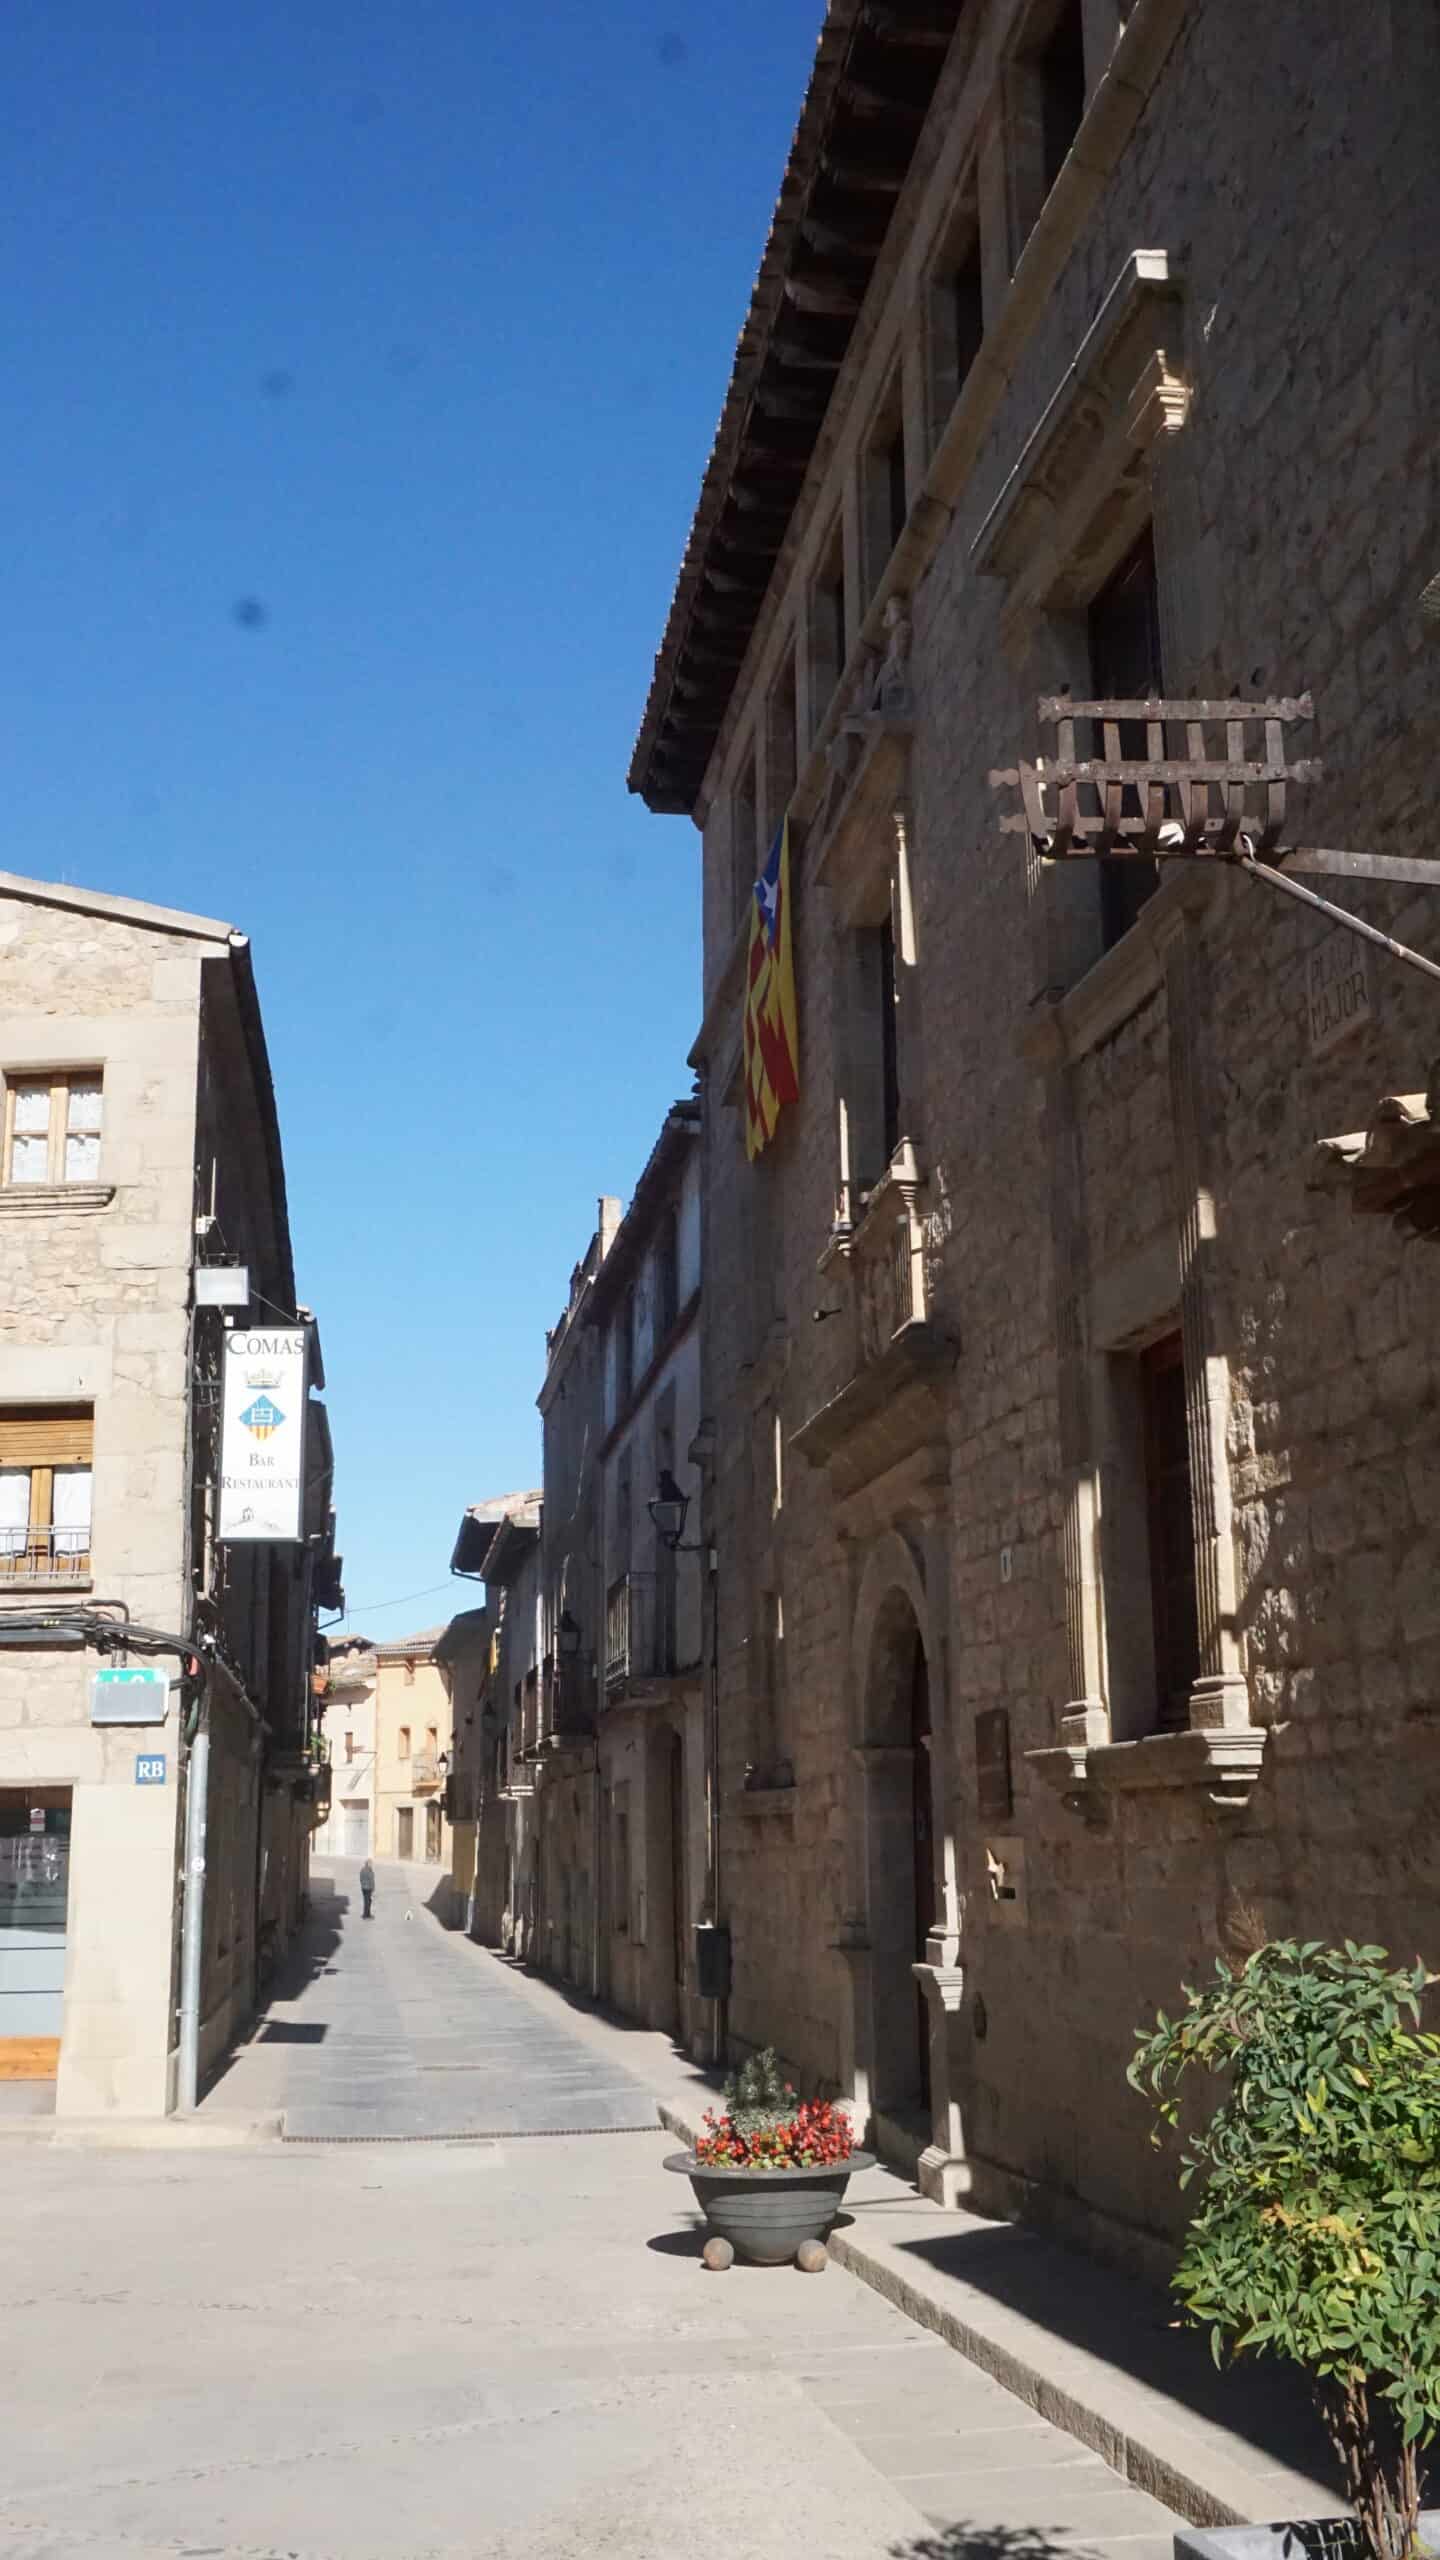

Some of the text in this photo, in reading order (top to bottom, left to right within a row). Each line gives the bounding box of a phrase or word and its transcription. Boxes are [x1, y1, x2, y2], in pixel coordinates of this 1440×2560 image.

[1311, 971, 1369, 1041] MAJOR
[226, 1332, 304, 1356] COMAS
[249, 1452, 275, 1467] BAR
[222, 1476, 301, 1489] RESTAURANT
[137, 1760, 164, 1778] RB
